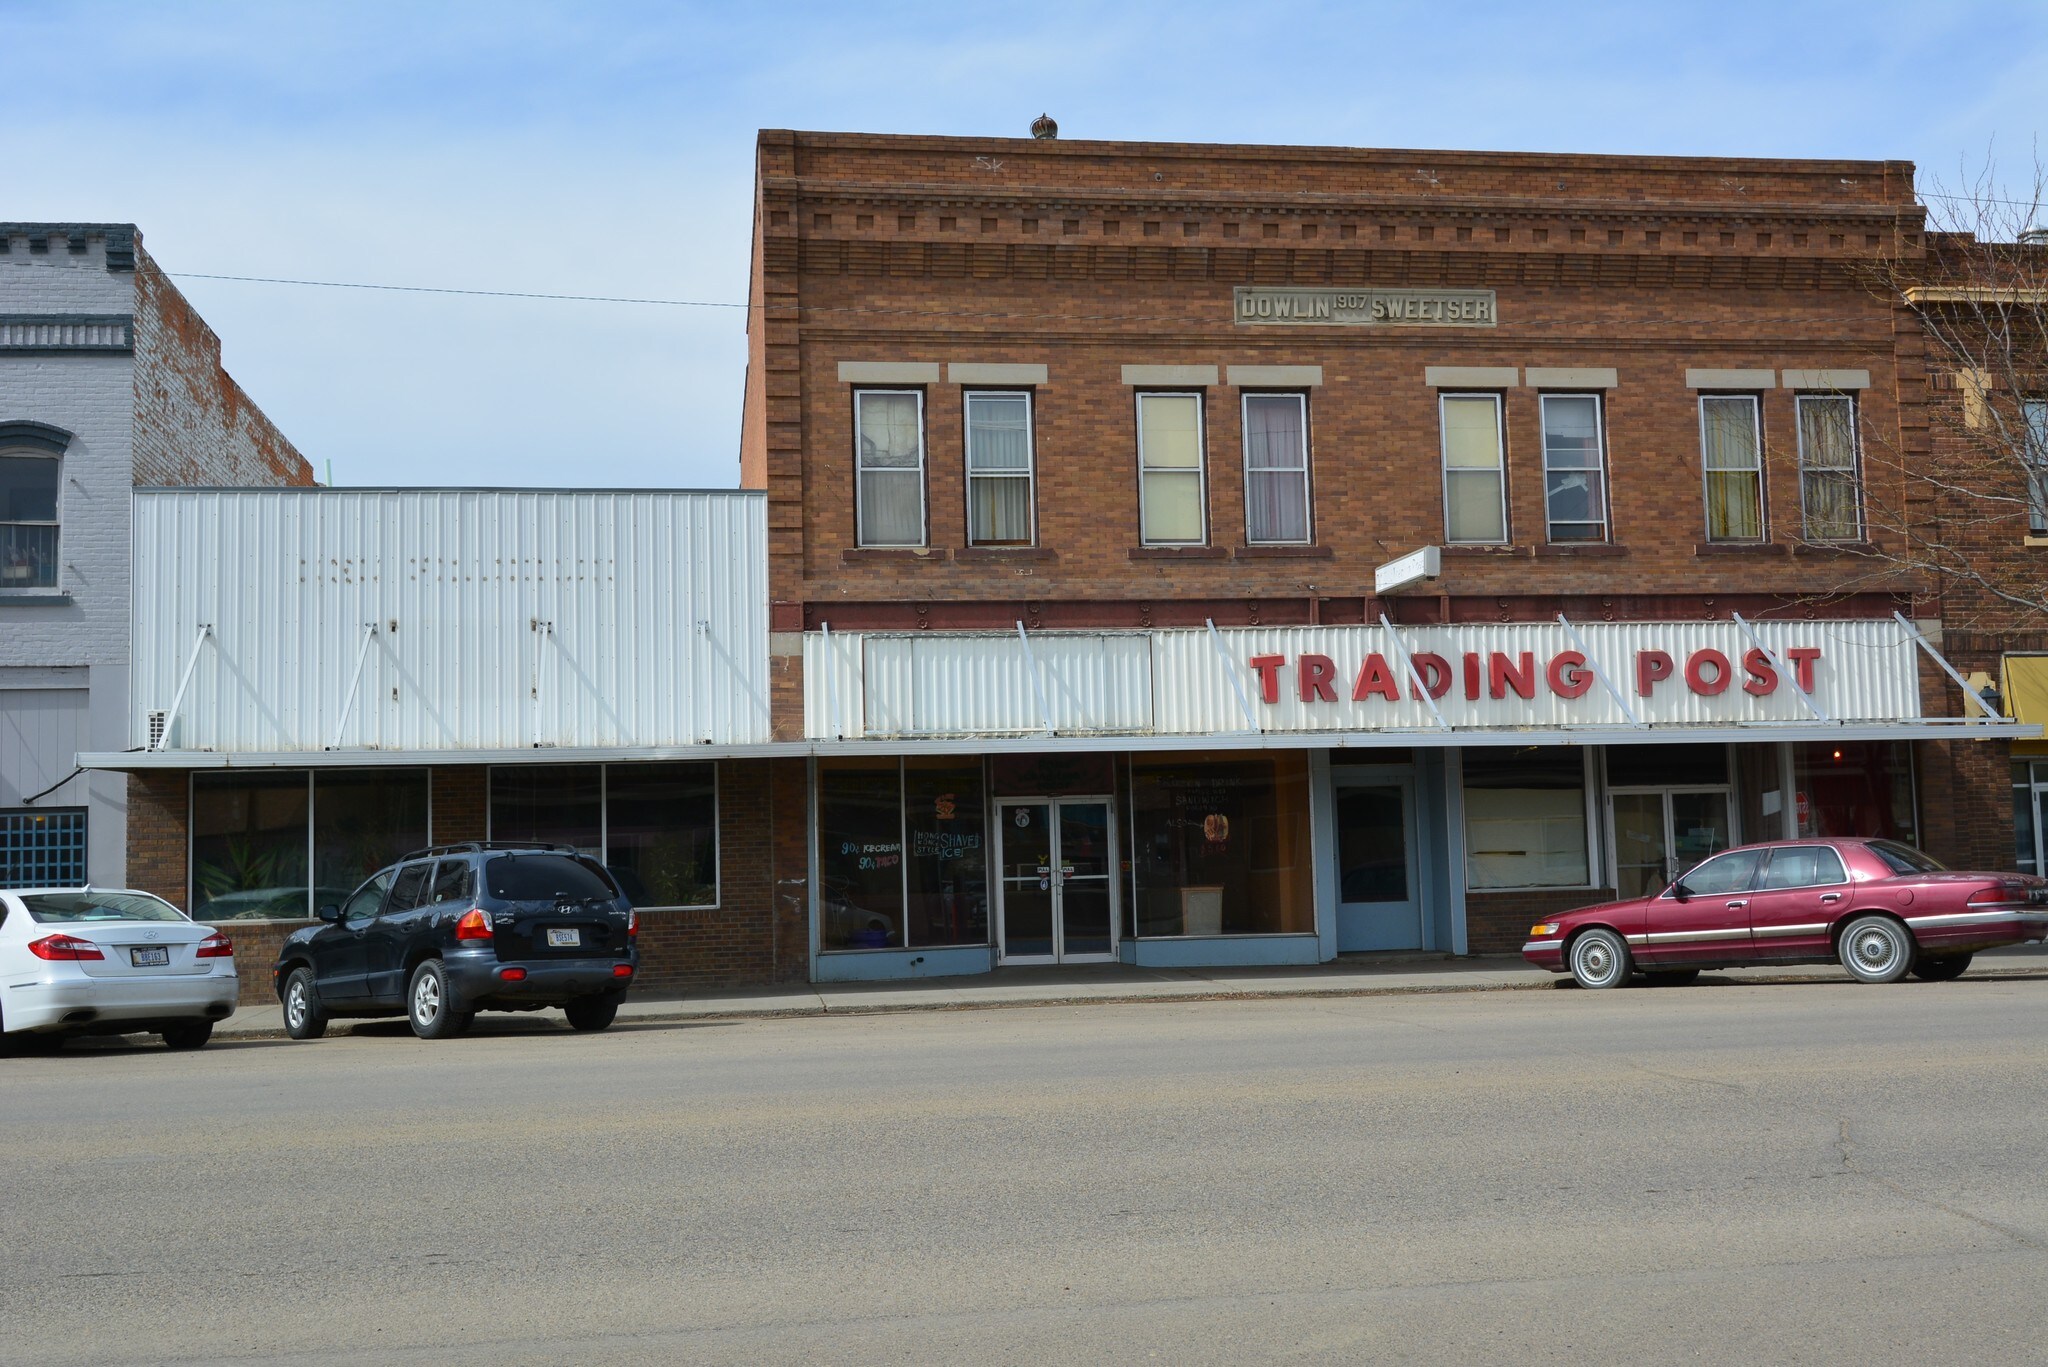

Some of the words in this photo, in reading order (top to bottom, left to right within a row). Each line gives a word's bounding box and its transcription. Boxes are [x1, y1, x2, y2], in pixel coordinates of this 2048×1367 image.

[1241, 295, 1330, 318] DOWLIN
[1333, 294, 1368, 309] 1907
[1371, 299, 1489, 319] SWEETSER
[1250, 650, 1594, 704] TRADING
[1636, 647, 1821, 698] POST
[917, 831, 939, 840] HONG
[942, 848, 961, 858] ICE
[875, 854, 899, 869] TACO
